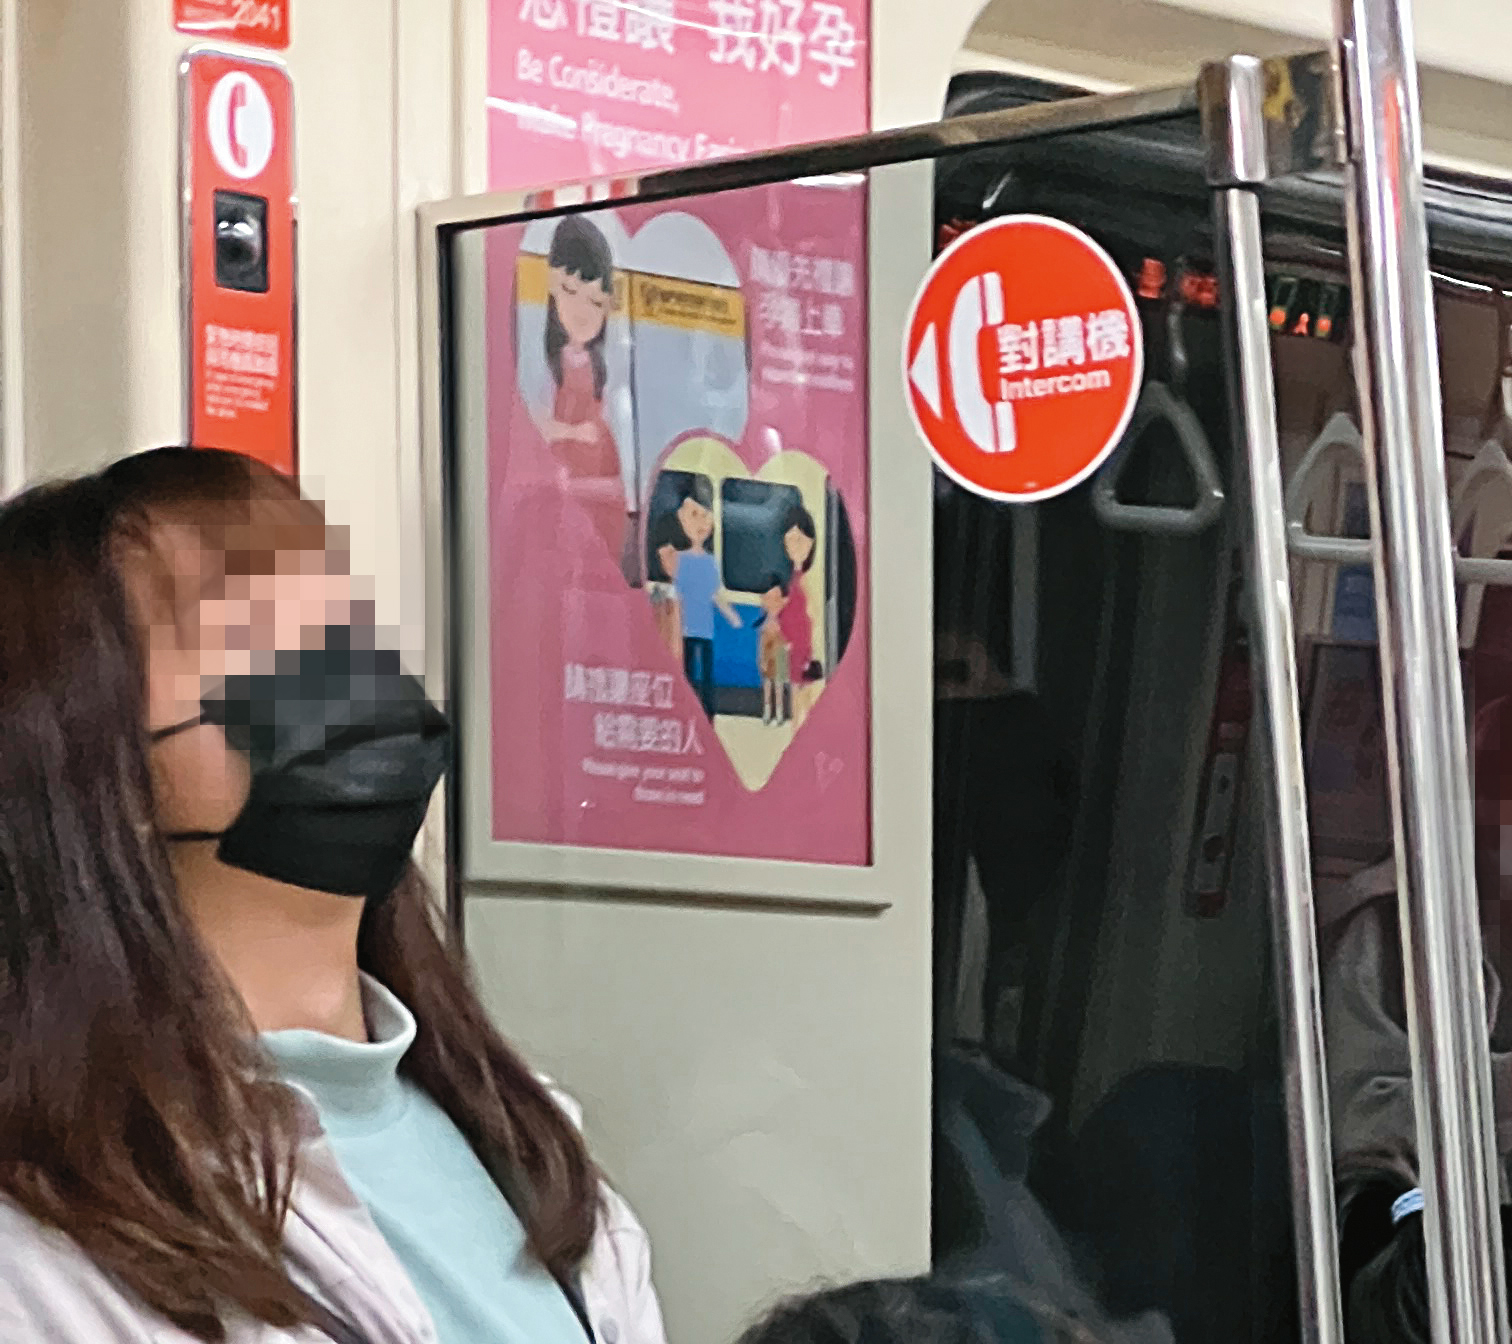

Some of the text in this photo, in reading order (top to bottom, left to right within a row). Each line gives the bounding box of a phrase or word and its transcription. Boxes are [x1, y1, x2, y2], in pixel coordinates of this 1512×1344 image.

[516, 48, 544, 84] Be
[707, 1, 858, 87] 我好孕
[997, 308, 1131, 374] 對講機
[1001, 369, 1111, 401] Intercom
